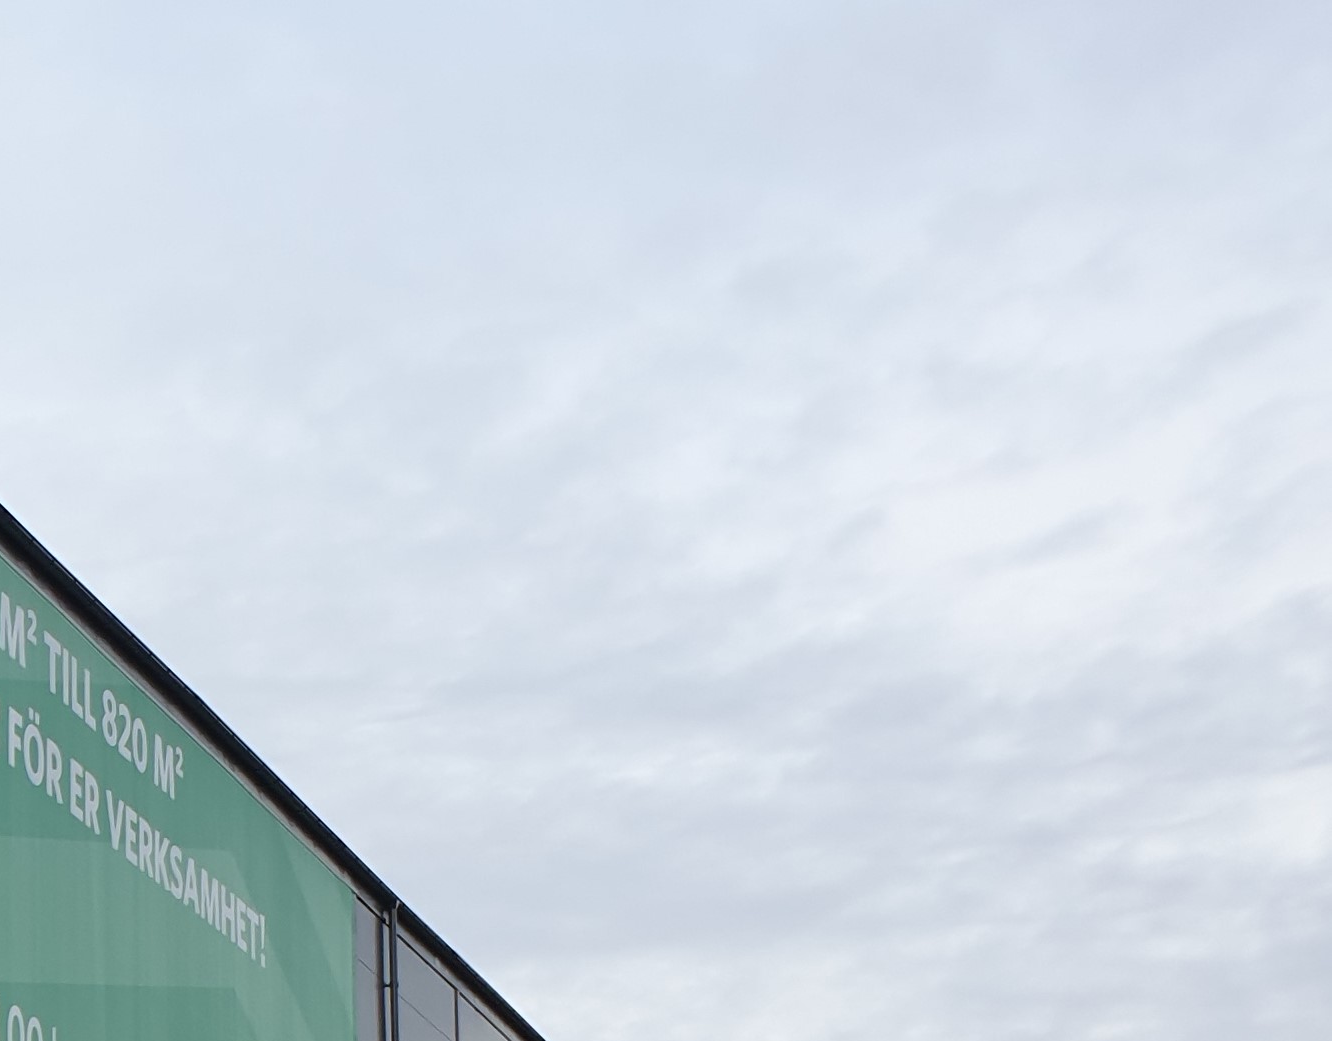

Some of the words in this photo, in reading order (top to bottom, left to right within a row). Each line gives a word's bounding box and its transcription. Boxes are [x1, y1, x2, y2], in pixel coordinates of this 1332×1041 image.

[43, 630, 96, 732] TILL
[102, 690, 148, 774] 820
[8, 706, 63, 804] FÖR
[70, 758, 100, 835] ER
[106, 789, 266, 968] VERKSAMHET!
